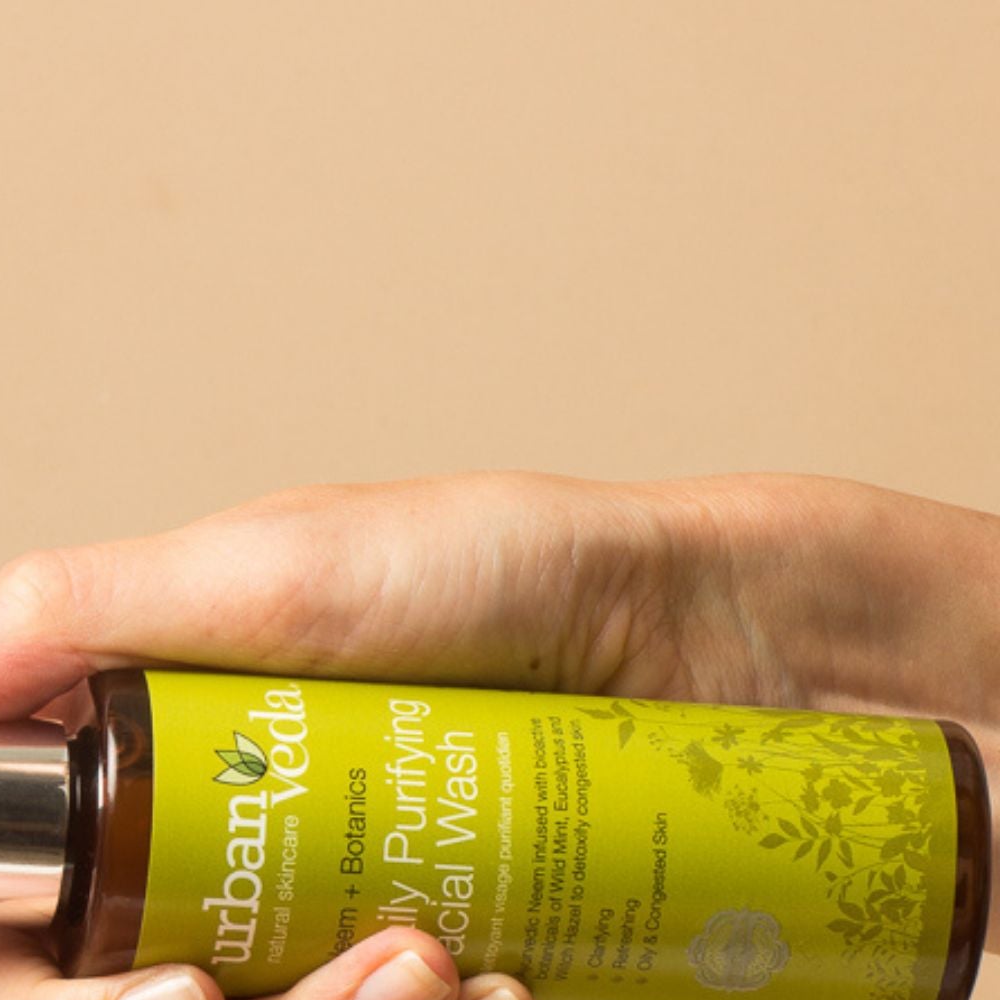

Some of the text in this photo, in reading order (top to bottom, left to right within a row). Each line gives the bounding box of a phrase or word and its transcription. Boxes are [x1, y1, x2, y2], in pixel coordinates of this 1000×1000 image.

[248, 689, 310, 809] veda
[530, 717, 548, 770] bioactive
[534, 771, 549, 803] with
[571, 744, 593, 816] congested
[340, 767, 367, 875] Botanics
[376, 698, 436, 929] ily Purifying
[433, 730, 478, 956] acial Wash
[497, 797, 513, 860] purifiant
[532, 805, 549, 863] infused
[202, 790, 268, 965] urban
[534, 715, 570, 980] botanicals of Wild Mint, Eucalyptus and
[573, 818, 592, 882] detoxify
[267, 814, 300, 964] natural skincare
[496, 864, 513, 913] visage
[527, 866, 546, 914] Neem
[571, 884, 584, 902] to
[637, 811, 668, 972] Oily & Congested Skin
[328, 907, 358, 957] eem
[564, 903, 582, 945] Hazel
[611, 898, 641, 970] Refreshing
[555, 945, 576, 982] Witch
